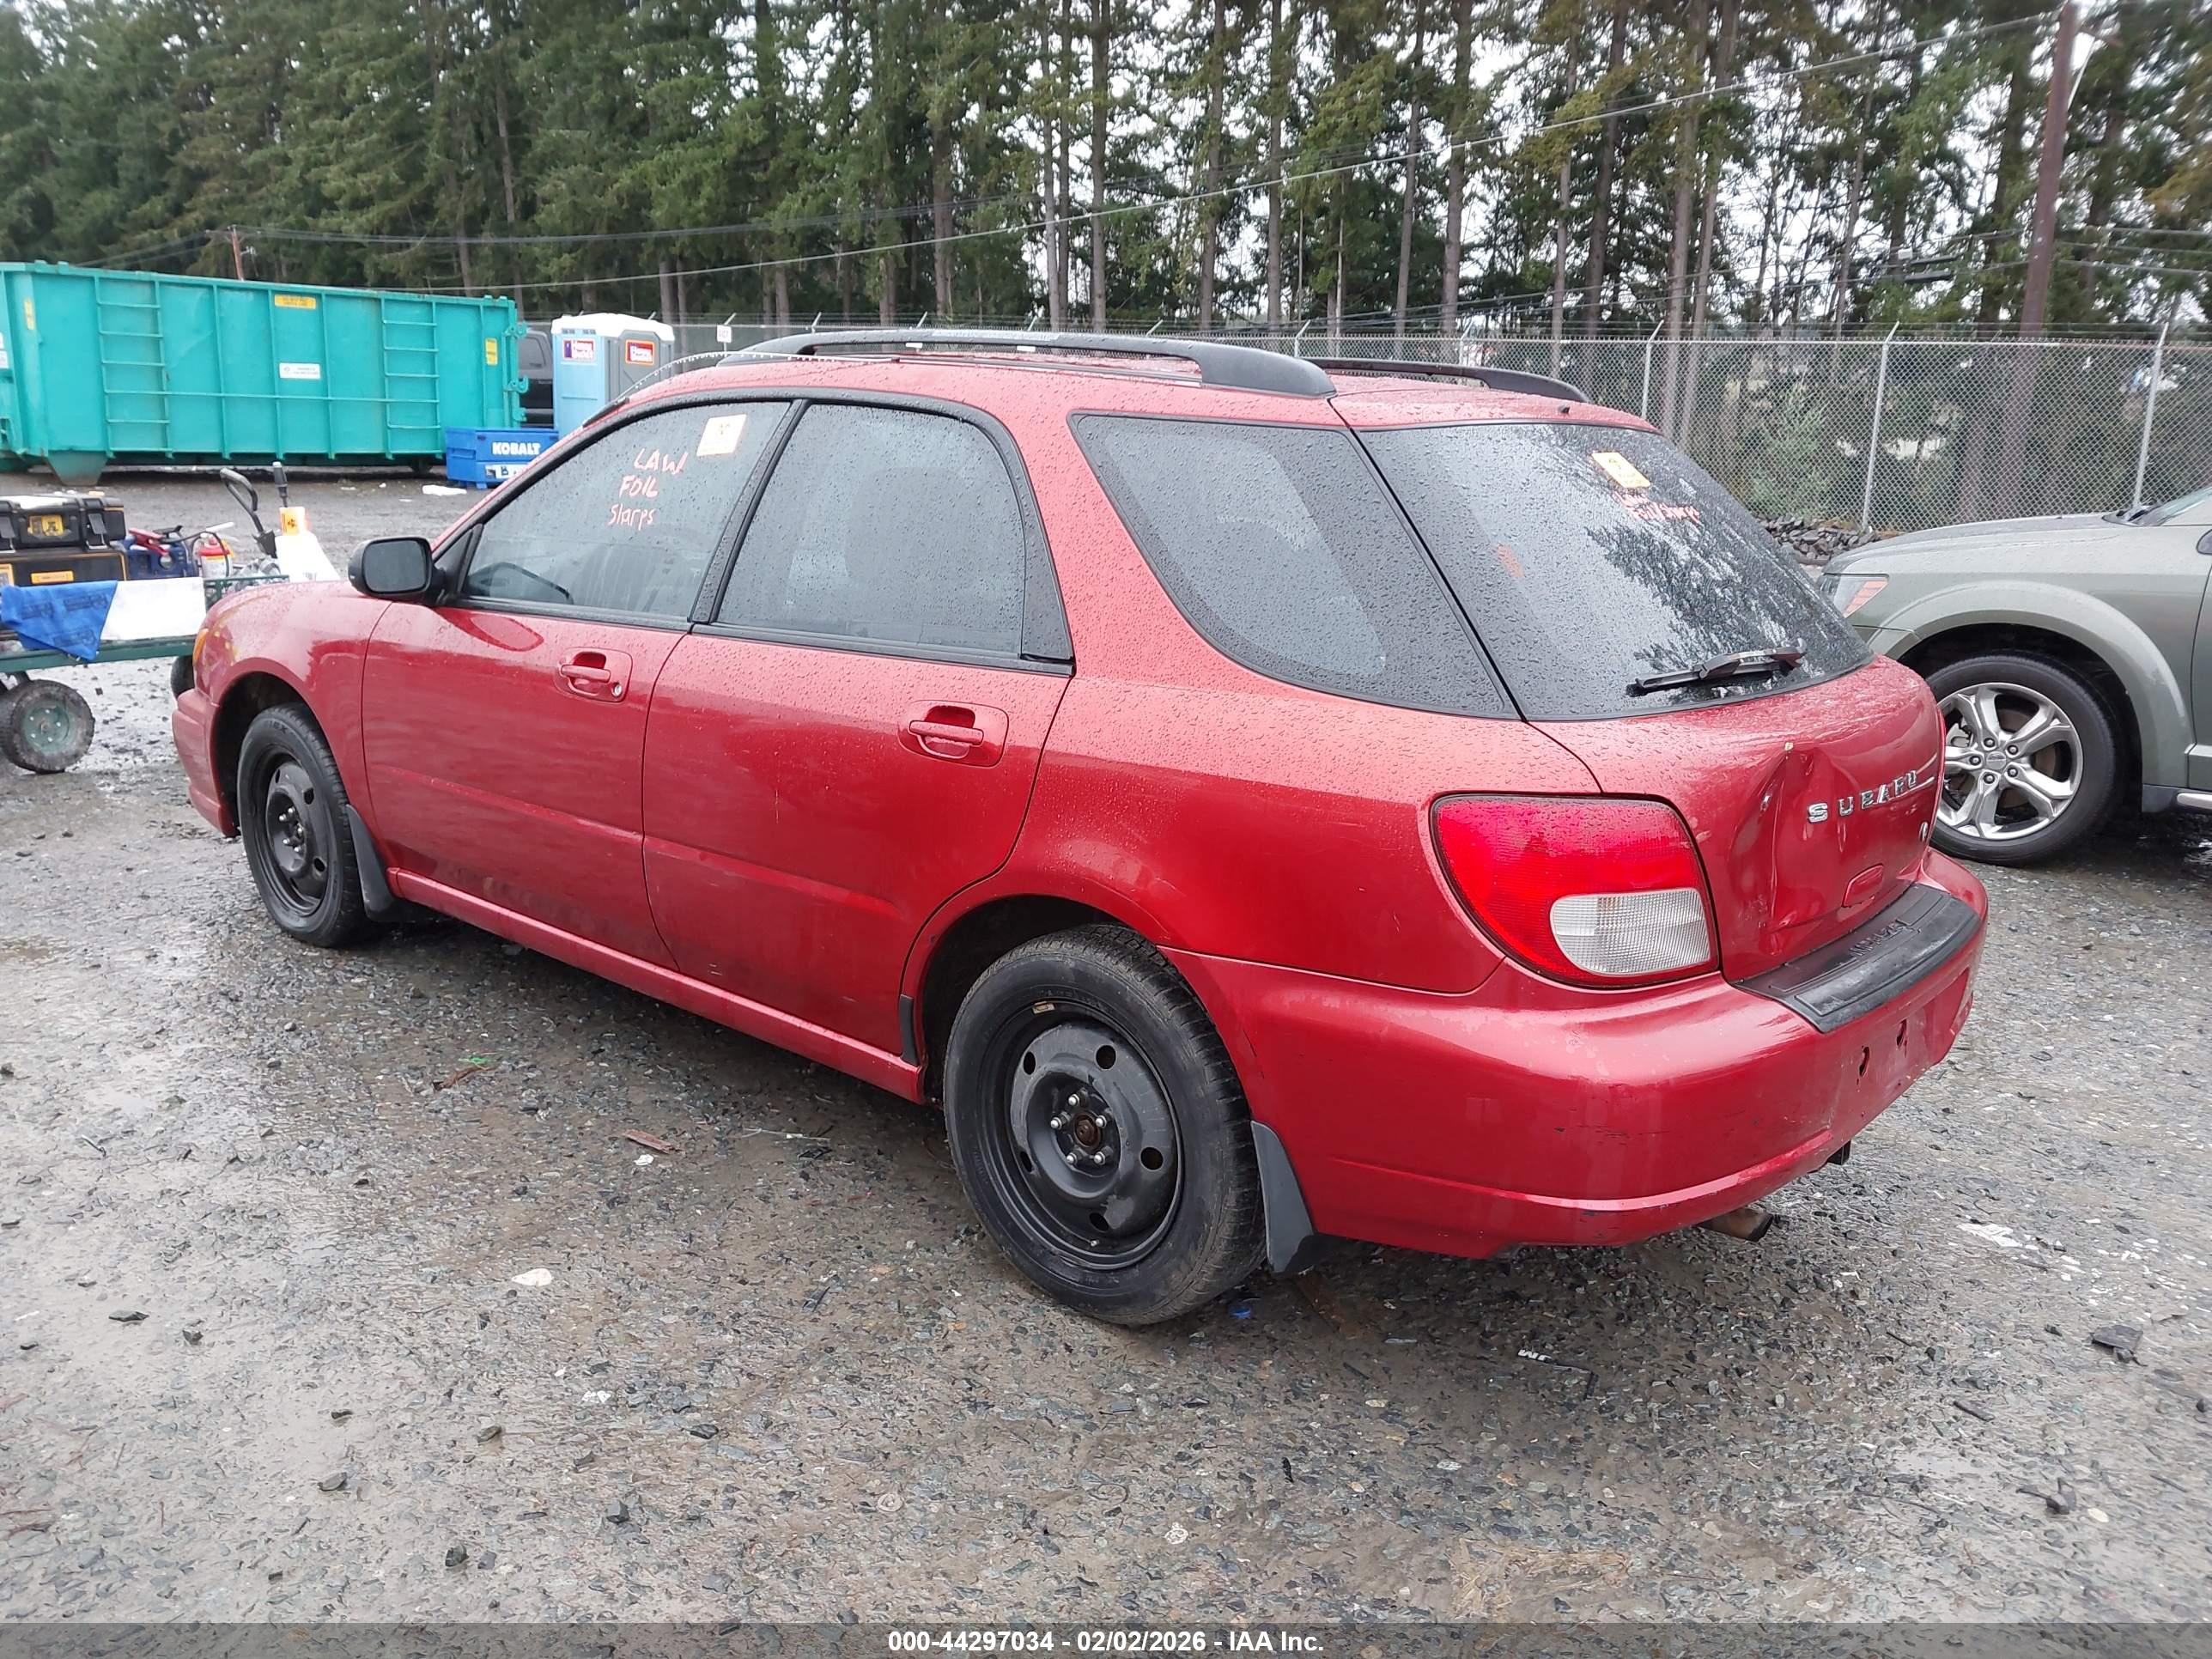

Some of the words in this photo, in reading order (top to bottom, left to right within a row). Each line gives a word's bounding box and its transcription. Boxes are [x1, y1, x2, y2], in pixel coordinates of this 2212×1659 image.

[492, 441, 541, 455] KOBALT
[634, 448, 689, 475] LAW
[618, 475, 659, 498] FOIL
[1808, 769, 1917, 823] SUBARU
